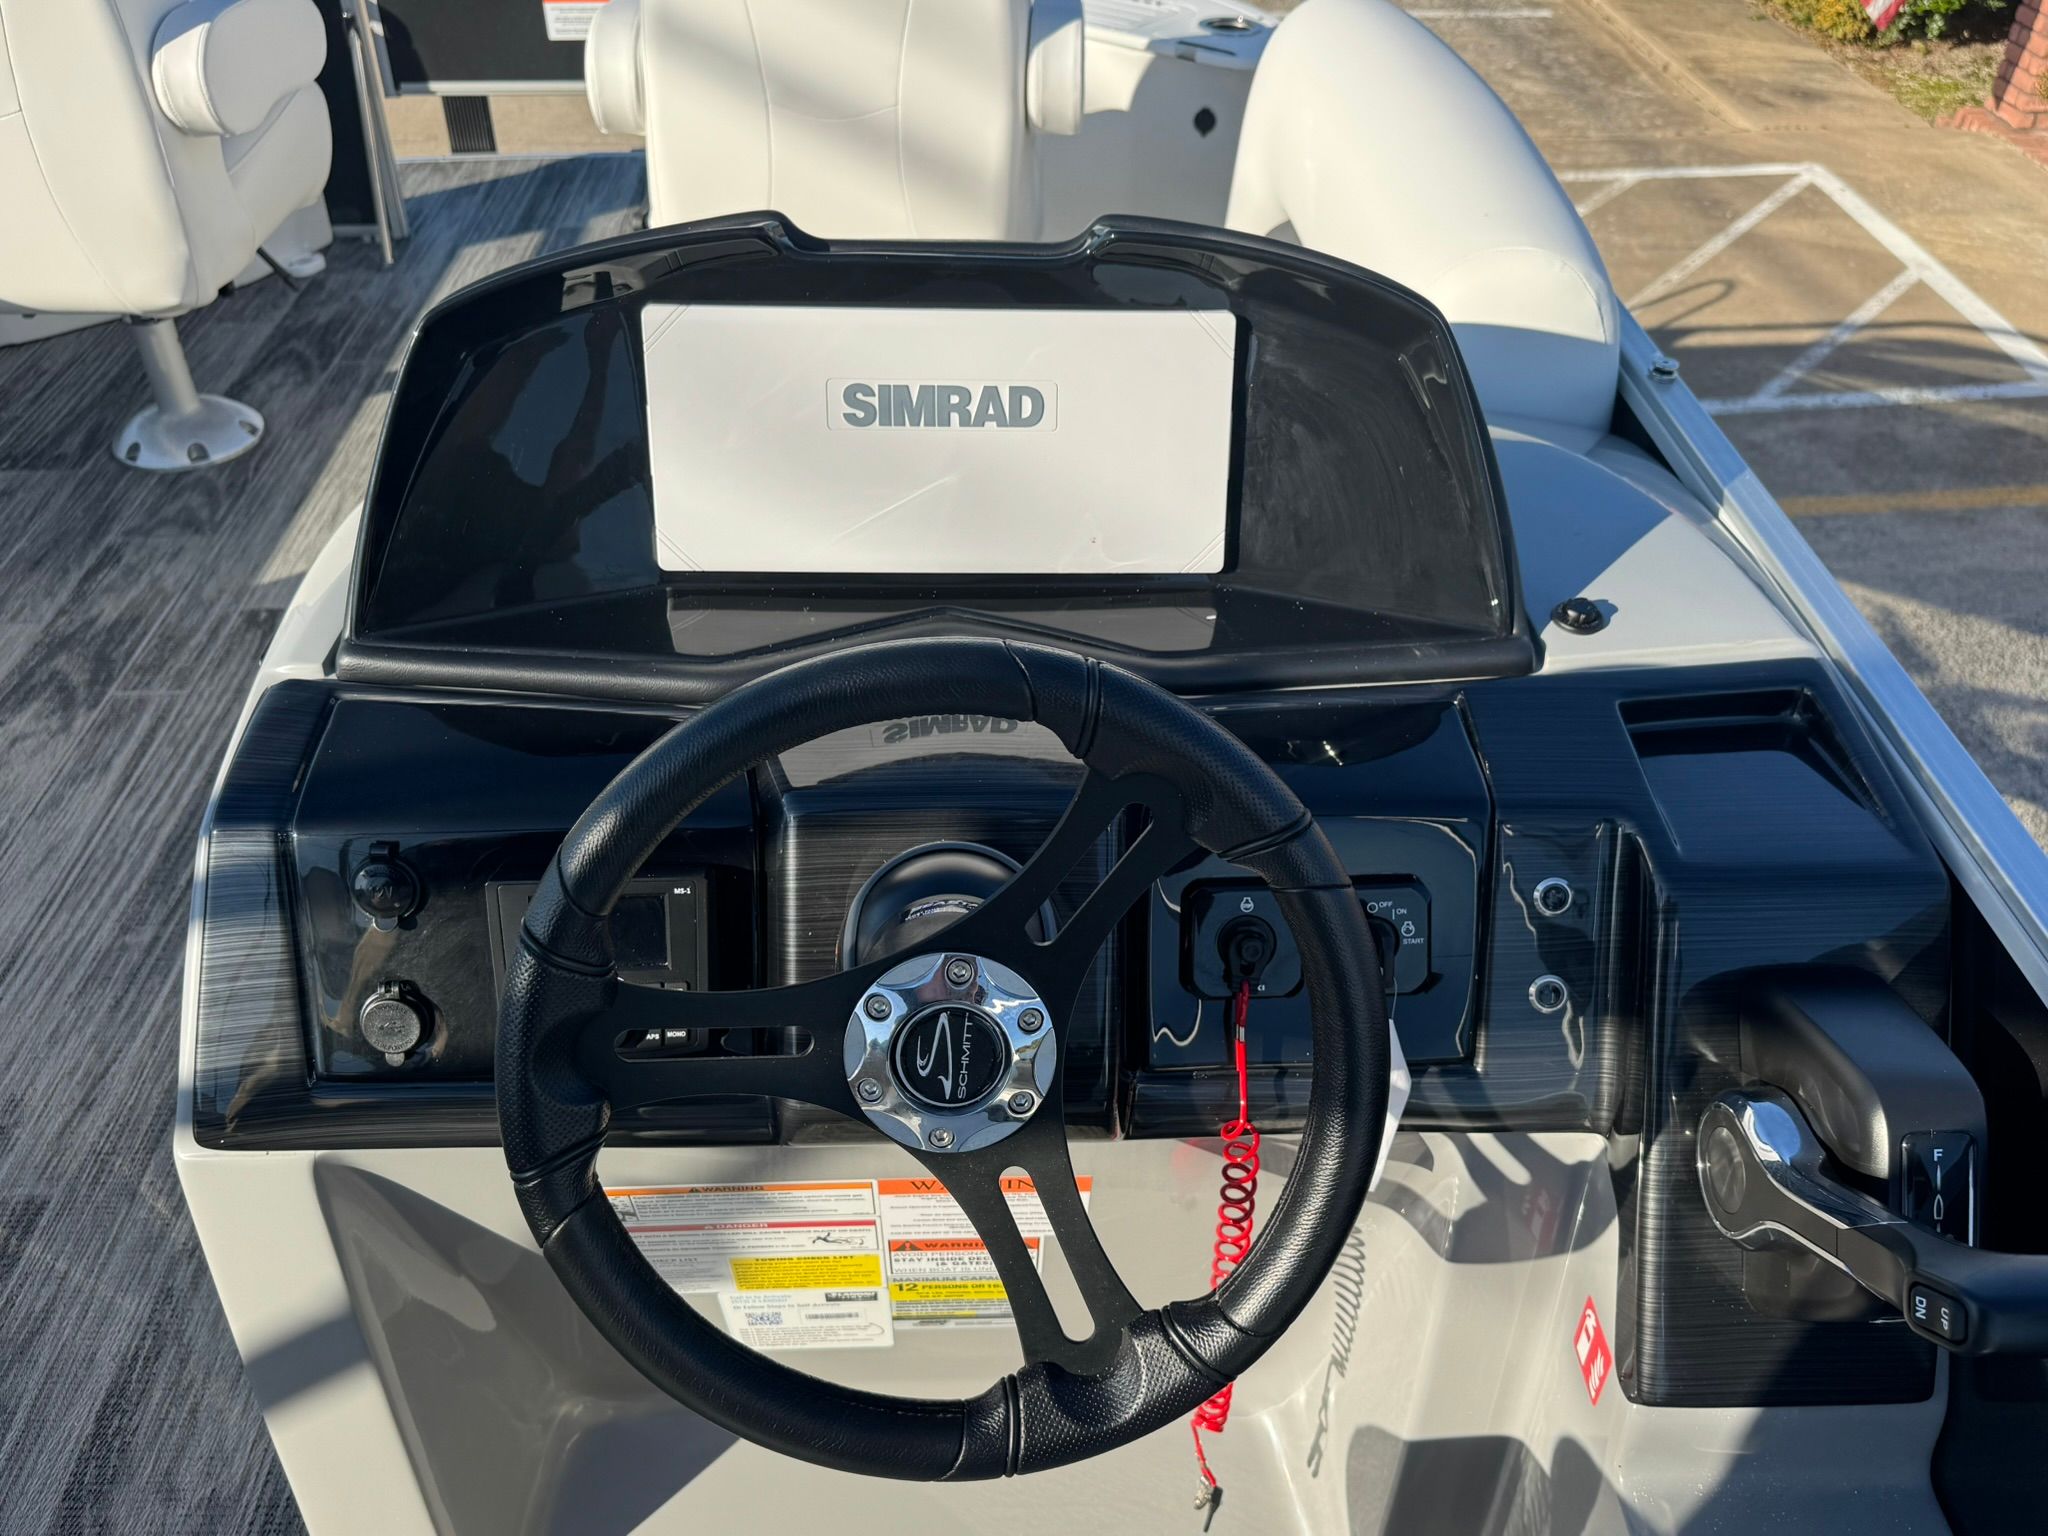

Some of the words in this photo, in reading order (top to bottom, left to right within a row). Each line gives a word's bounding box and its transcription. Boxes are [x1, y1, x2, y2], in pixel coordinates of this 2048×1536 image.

[842, 382, 1045, 428] SIMRAD
[1402, 937, 1425, 945] START
[957, 1011, 974, 1100] SCHMITT
[1933, 1148, 1943, 1162] F
[702, 1185, 765, 1193] WARNING
[716, 1222, 769, 1230] DANGER
[894, 1283, 919, 1292] 12
[1915, 1295, 1927, 1320] DN
[1940, 1306, 1950, 1331] UP
